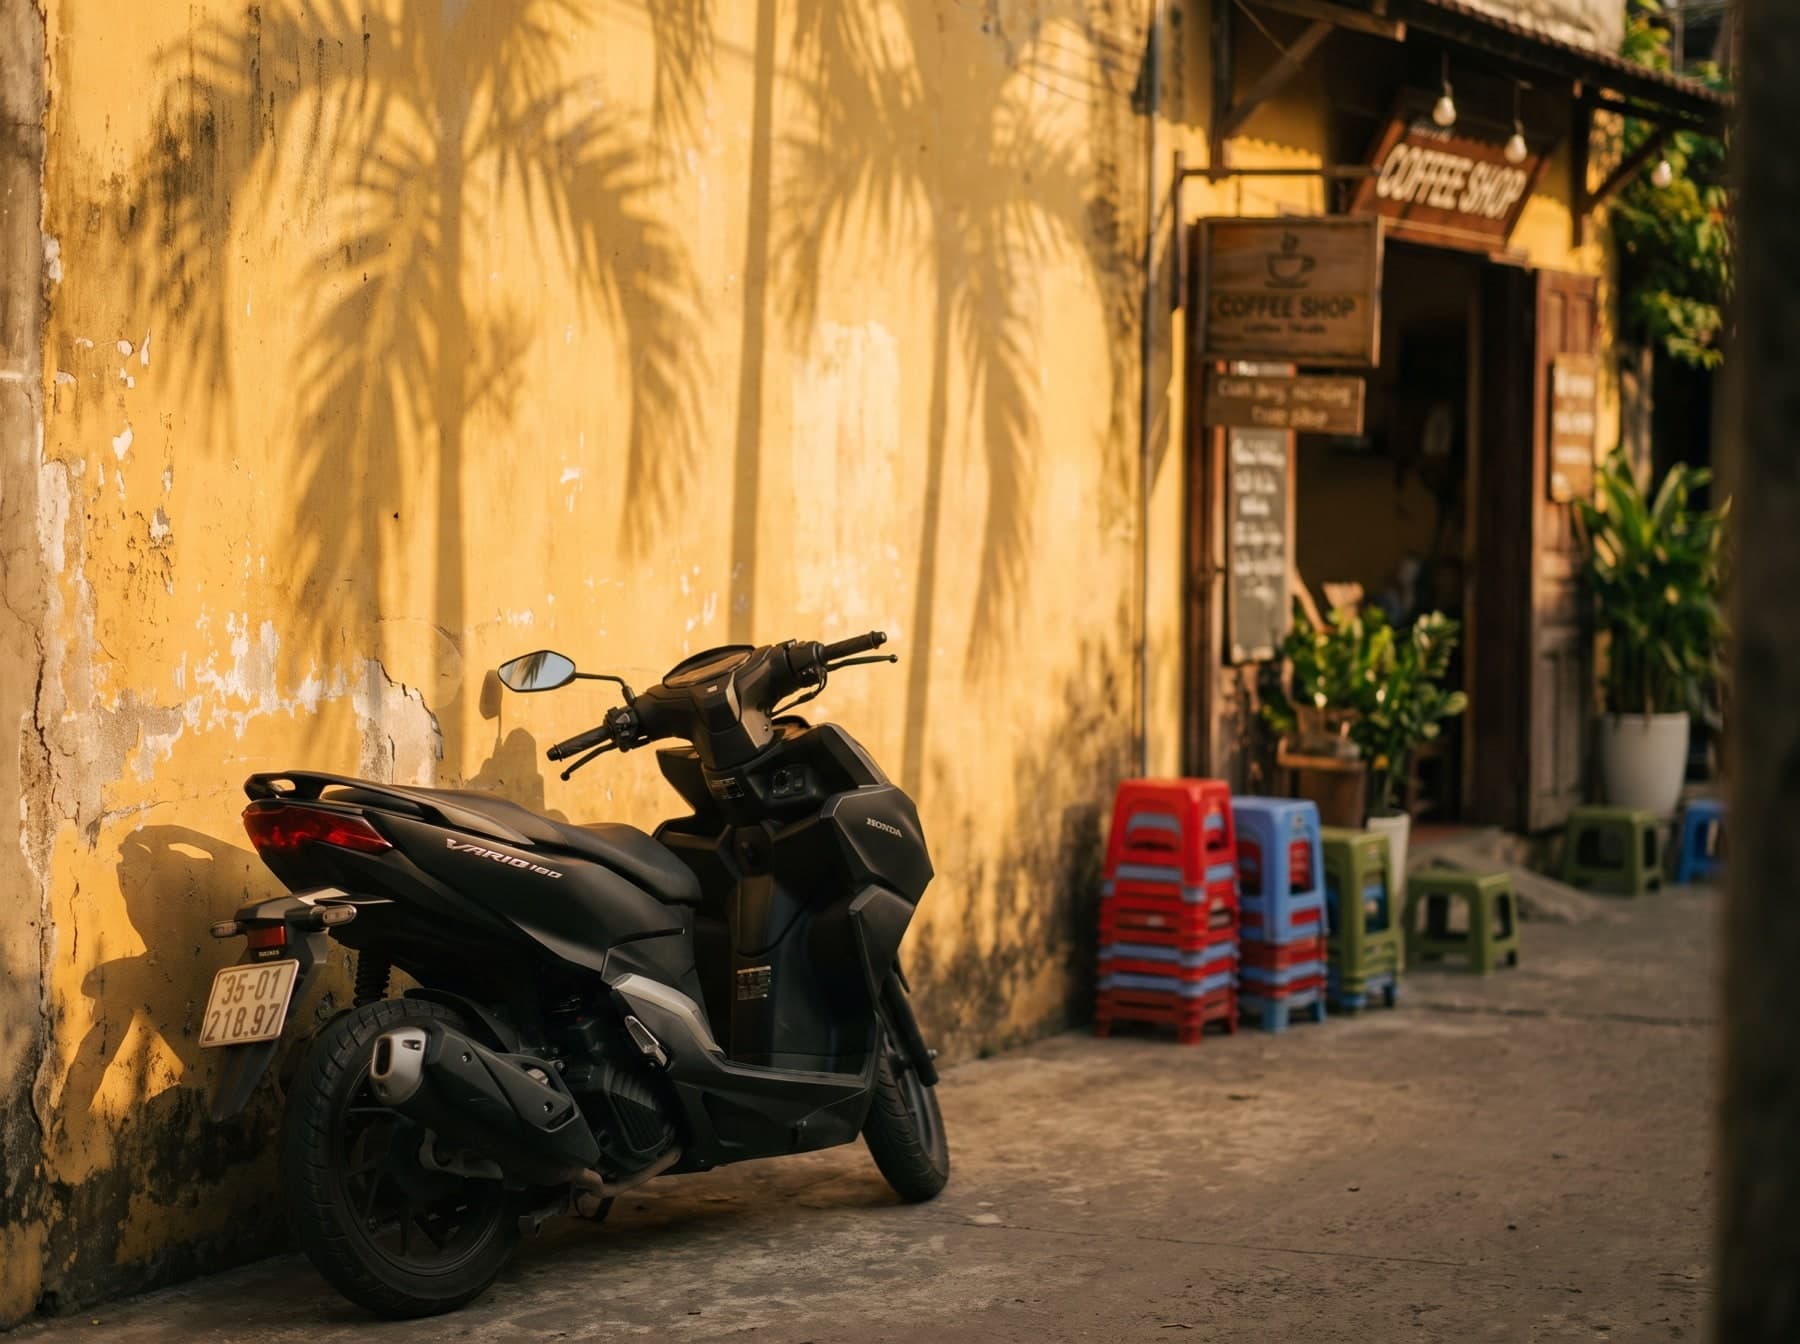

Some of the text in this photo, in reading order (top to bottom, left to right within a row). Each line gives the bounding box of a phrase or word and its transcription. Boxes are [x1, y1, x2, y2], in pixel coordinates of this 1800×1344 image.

[1376, 144, 1526, 219] COFFEE SHOP
[1218, 296, 1356, 319] COFFEE SHOP
[866, 817, 902, 838] HONDA
[446, 838, 530, 869] VARIO
[221, 967, 281, 1005] 35-01
[205, 1003, 280, 1041] 218.97
